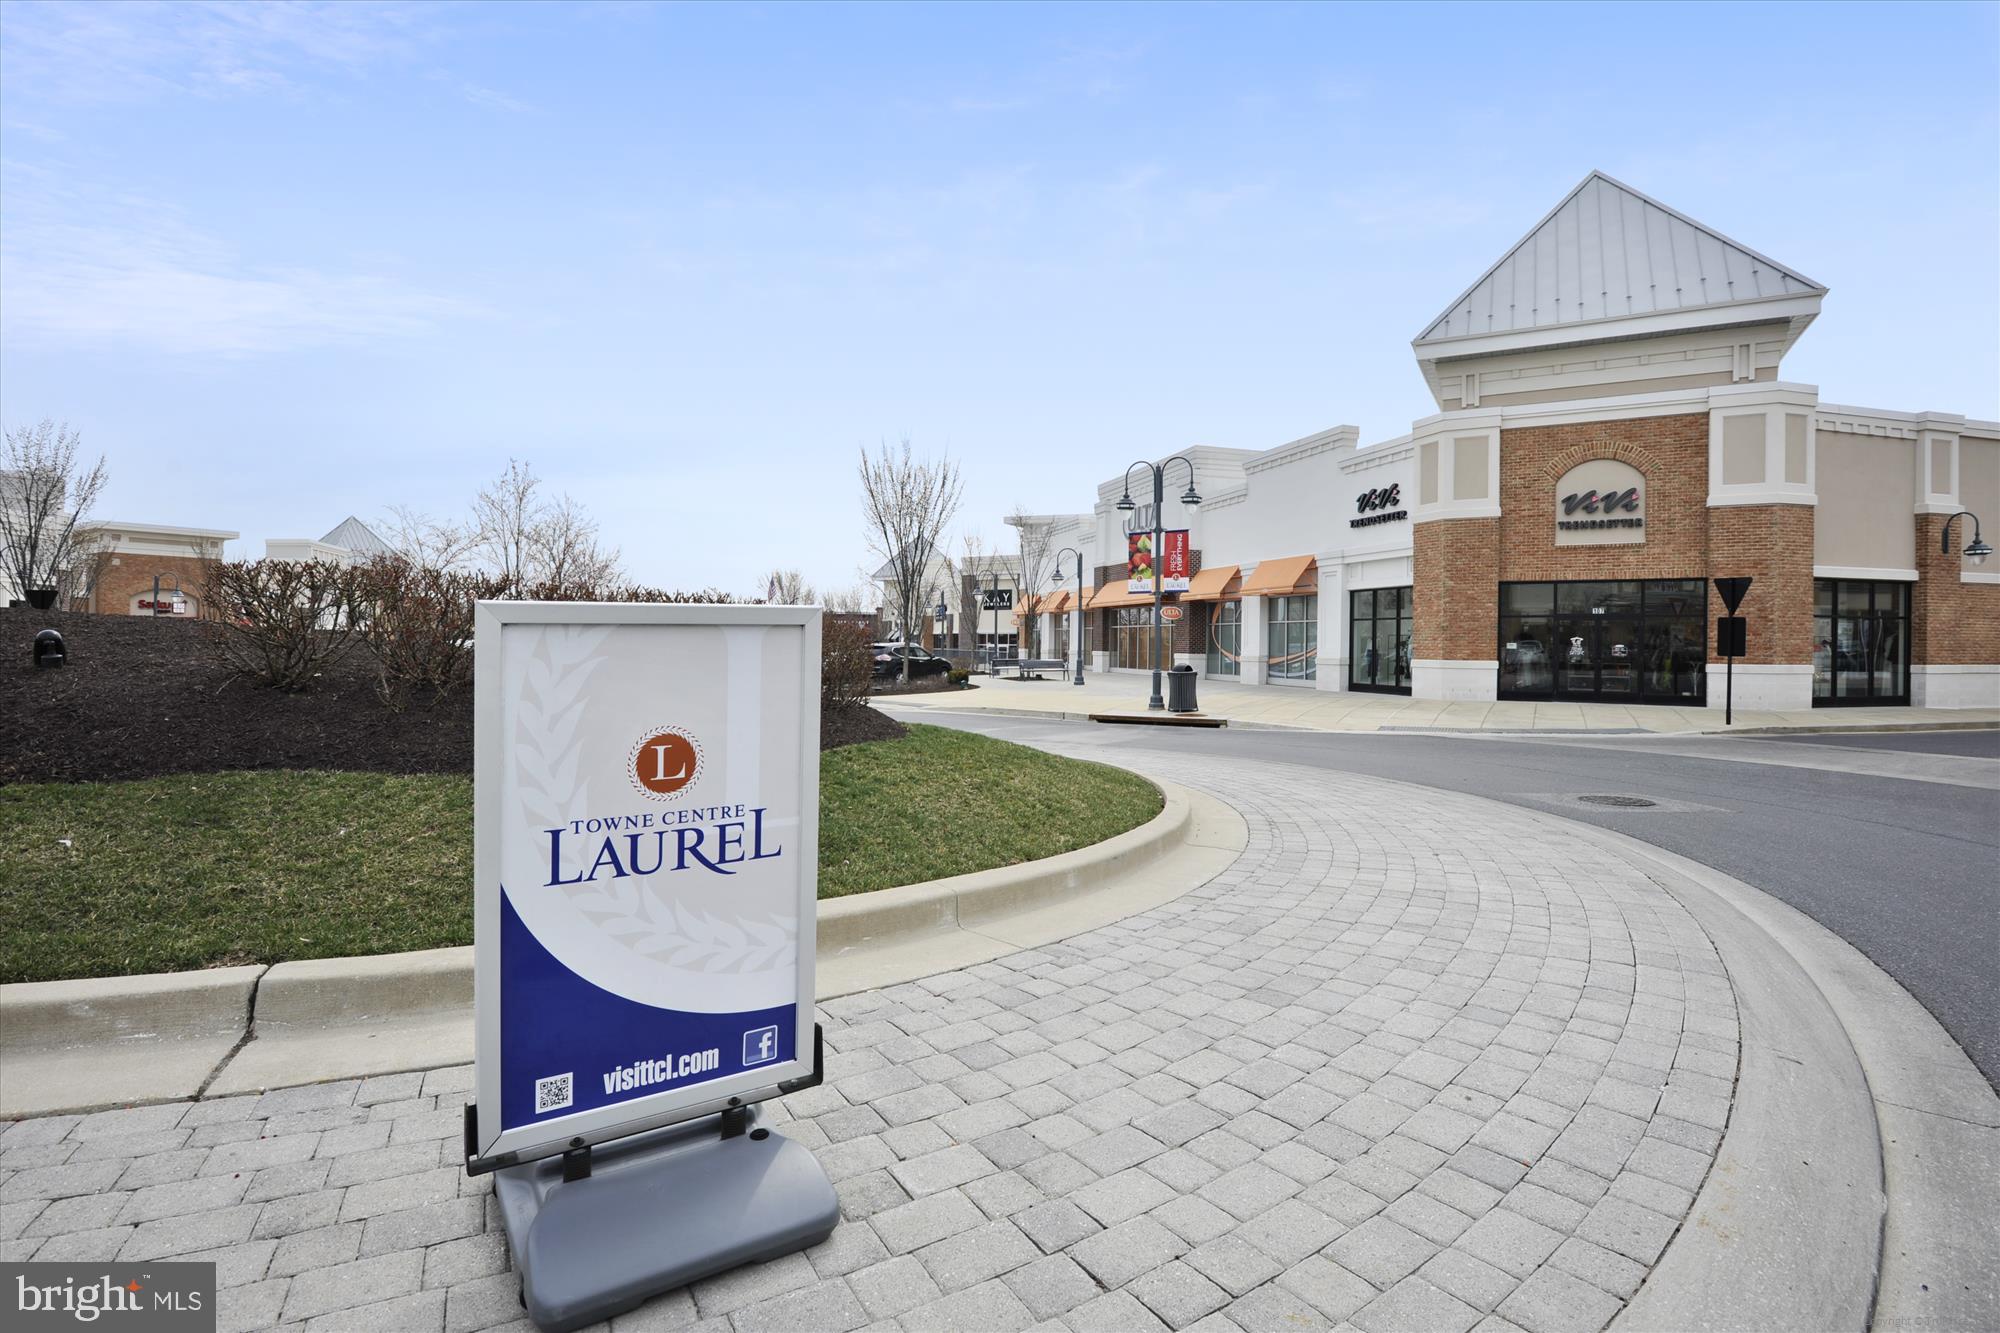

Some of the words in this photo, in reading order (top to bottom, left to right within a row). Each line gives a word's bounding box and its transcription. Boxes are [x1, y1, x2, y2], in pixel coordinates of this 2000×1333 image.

[1558, 518, 1643, 530] TRENDSETTER
[651, 744, 686, 781] L
[570, 813, 654, 835] TOWNE
[662, 804, 746, 826] CENTRE
[543, 807, 782, 887] LAUREL
[603, 1048, 720, 1095] visittcl.com
